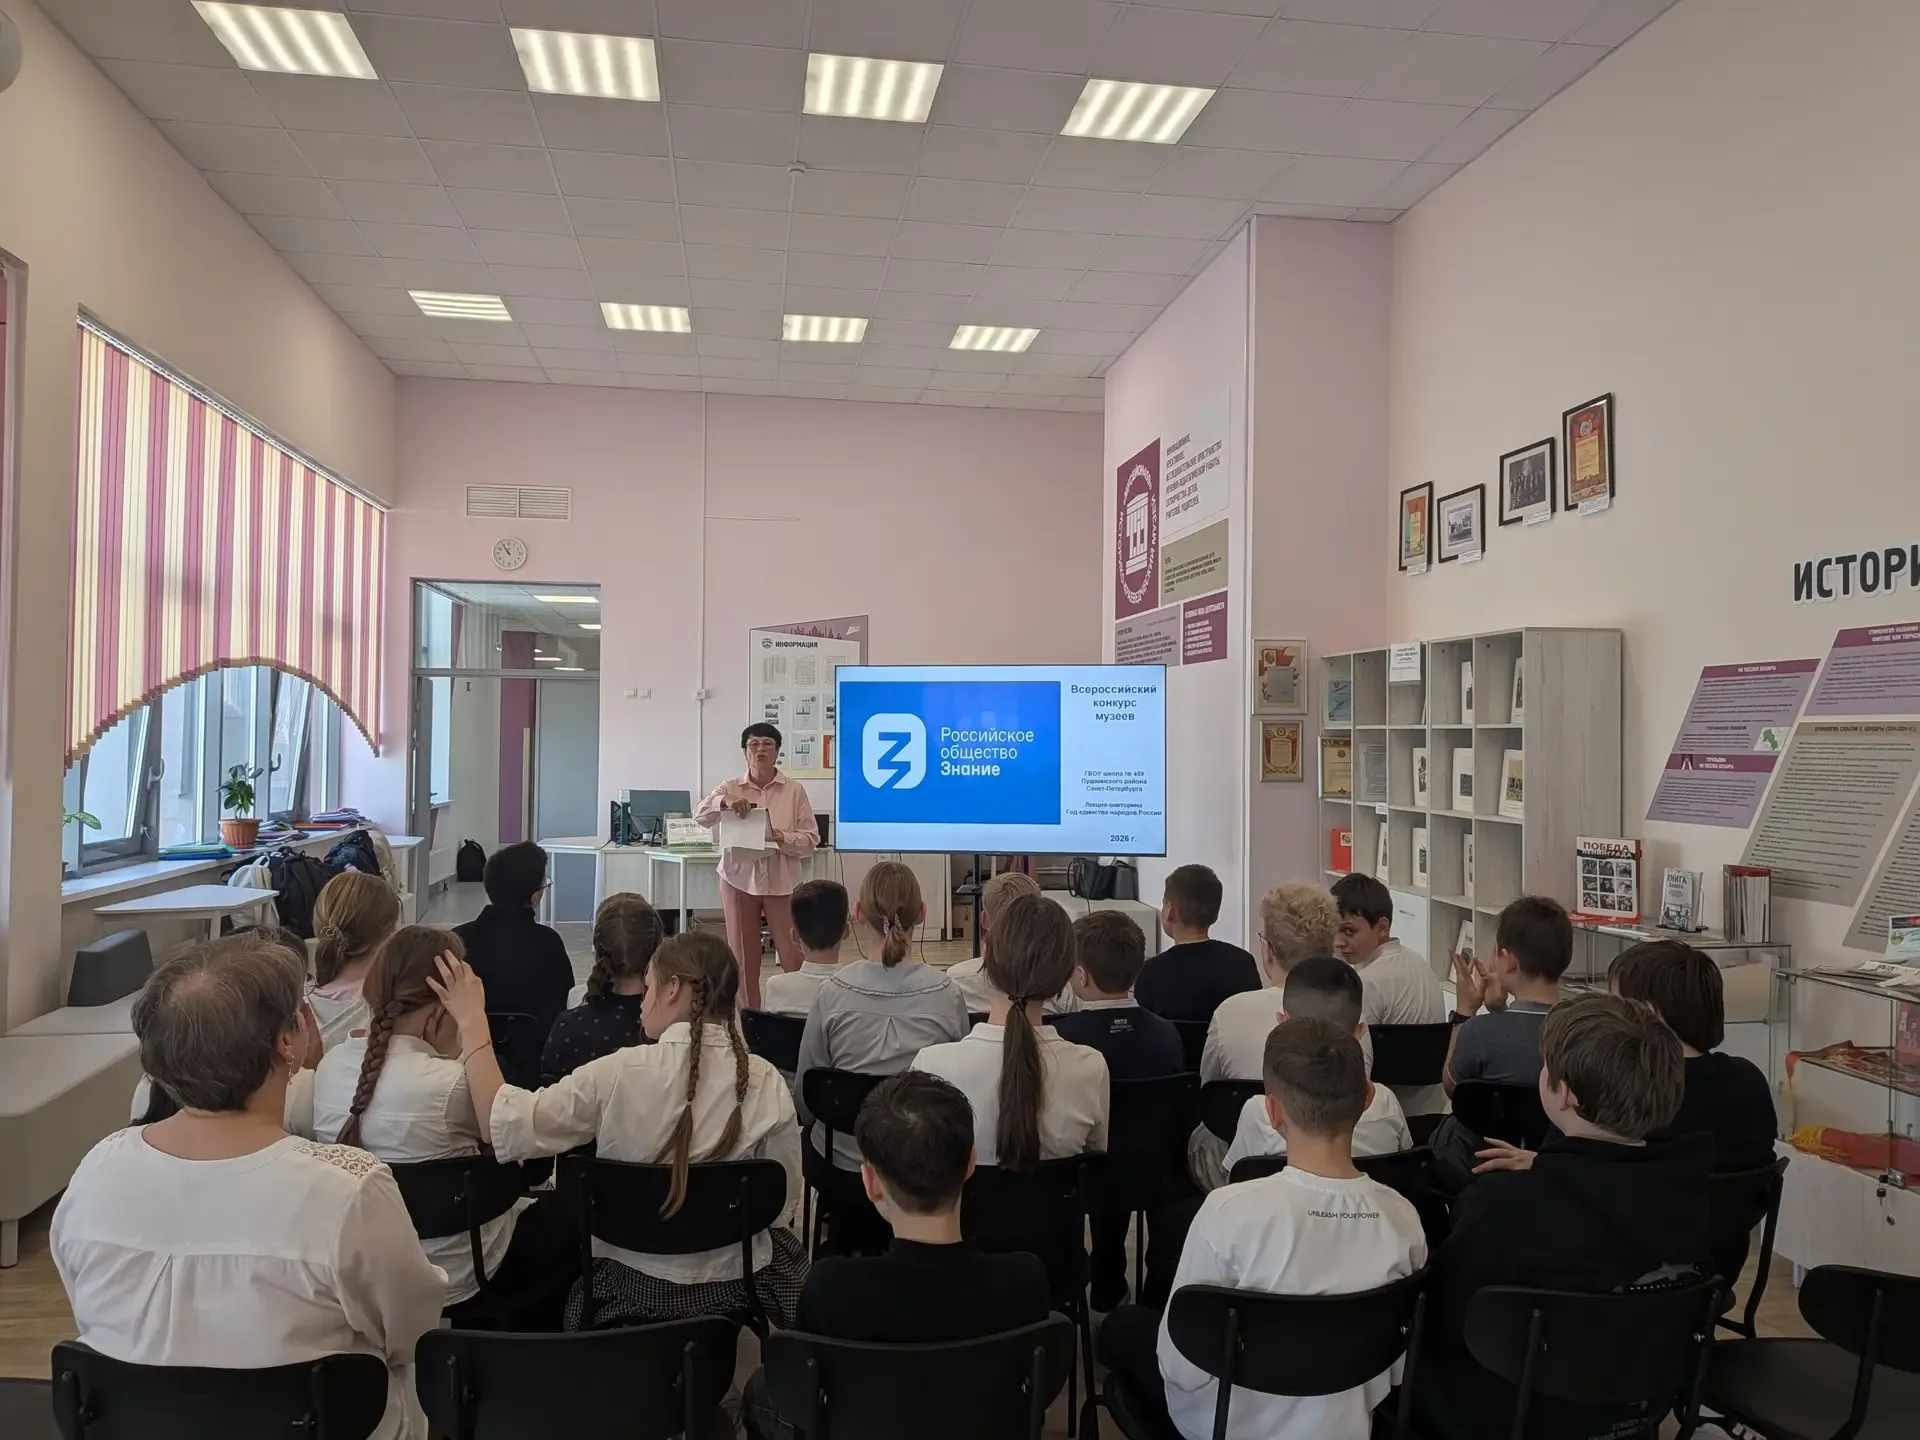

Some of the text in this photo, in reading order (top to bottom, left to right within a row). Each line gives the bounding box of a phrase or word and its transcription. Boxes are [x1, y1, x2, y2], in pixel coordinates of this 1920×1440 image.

[1071, 683, 1157, 696] Всероссийский
[1093, 699, 1137, 709] конкурс
[1095, 713, 1135, 722] музеев
[941, 727, 1034, 743] Российское
[940, 744, 1018, 761] общество
[940, 761, 1000, 776] Знание
[1583, 841, 1630, 853] ПОБЕДА
[1581, 850, 1632, 858] ЛЕНИНГРАДА
[1308, 1209, 1337, 1218] UNLEASH
